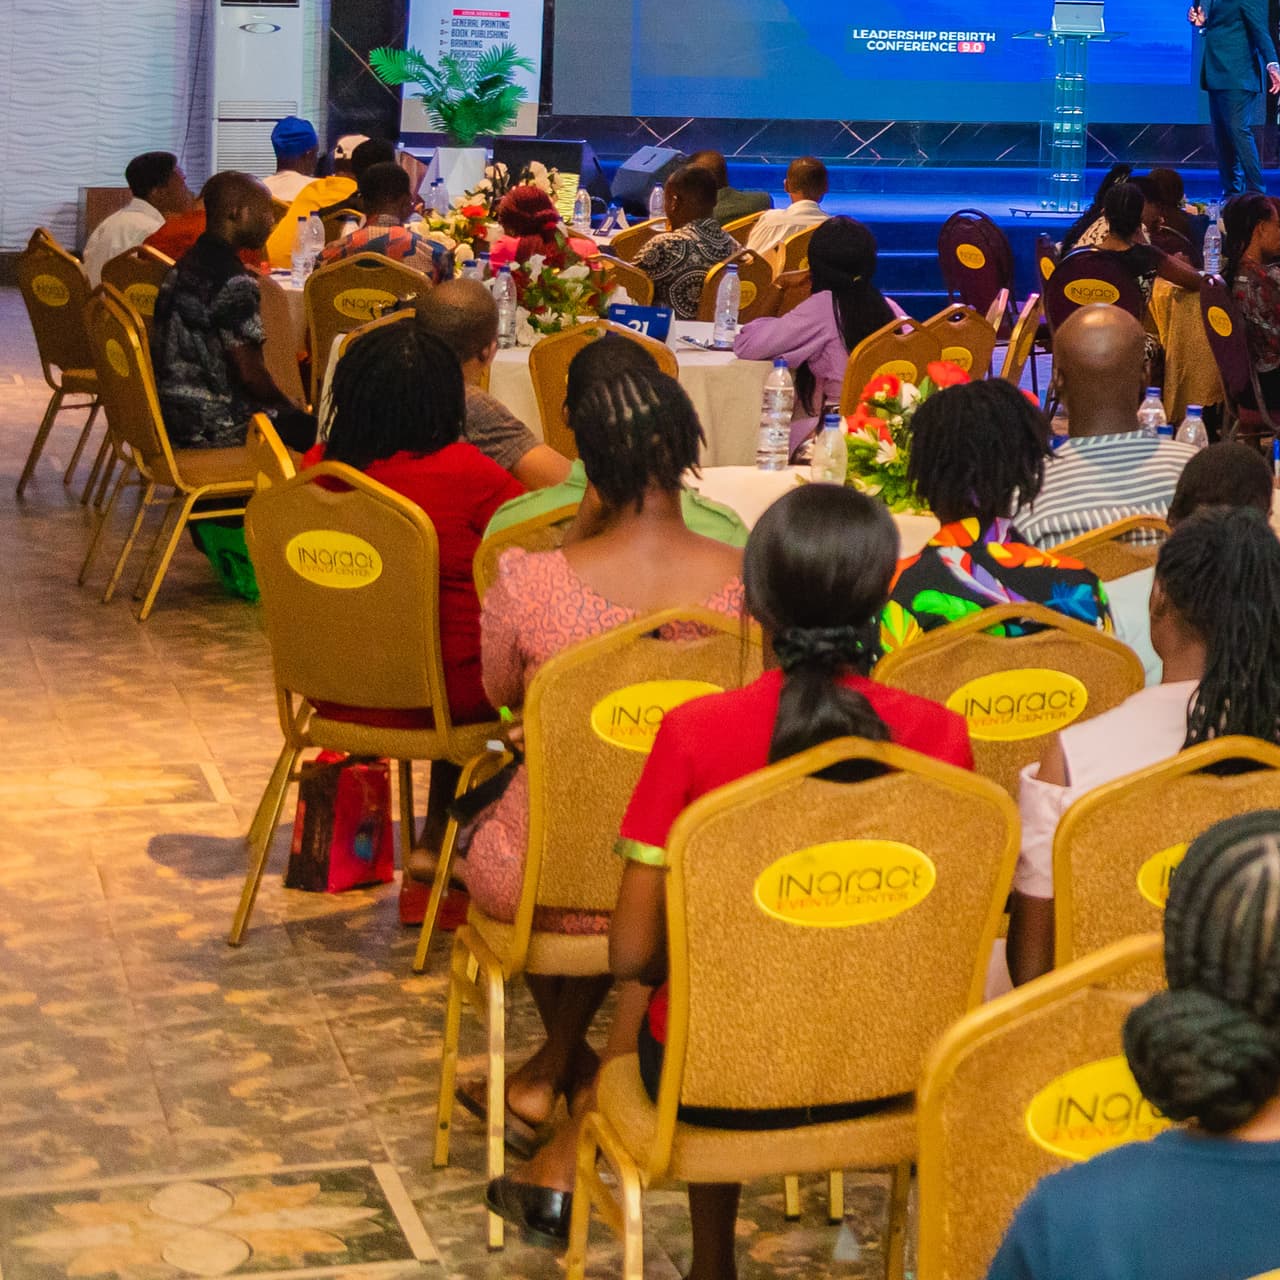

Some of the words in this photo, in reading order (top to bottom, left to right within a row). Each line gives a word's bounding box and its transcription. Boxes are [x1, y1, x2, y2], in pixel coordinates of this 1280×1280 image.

[452, 18, 479, 28] GENERAL
[481, 20, 511, 30] PRINTING
[451, 28, 468, 38] BOOK
[853, 29, 938, 41] LEADERSHIP
[940, 31, 997, 43] REBIRTH
[867, 40, 958, 53] CONFERENCE
[963, 43, 983, 53] 9.0
